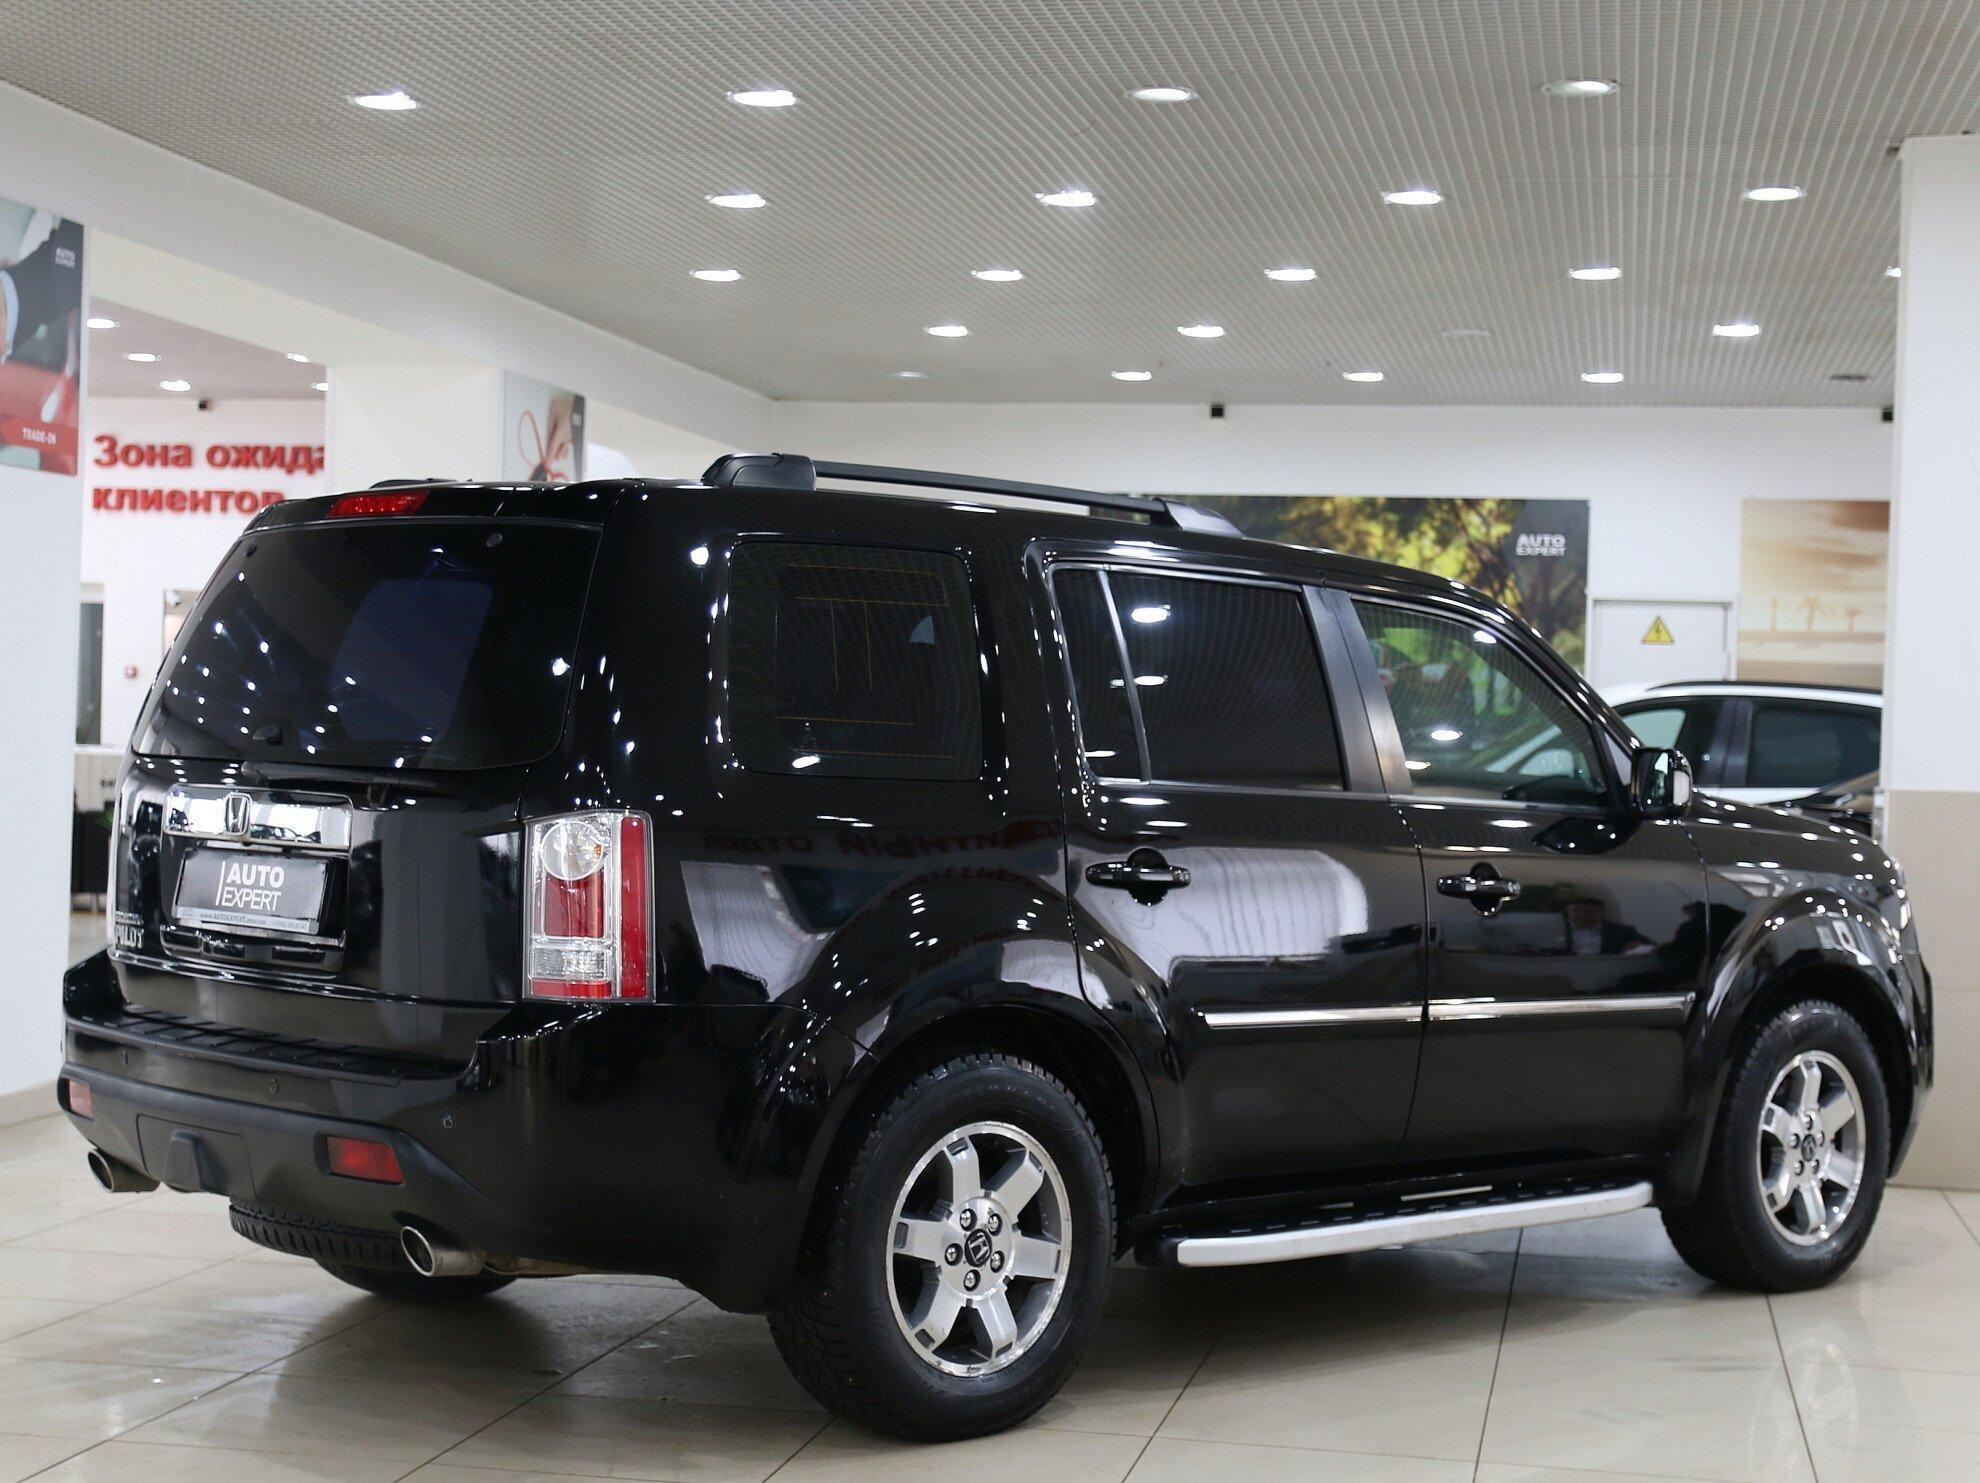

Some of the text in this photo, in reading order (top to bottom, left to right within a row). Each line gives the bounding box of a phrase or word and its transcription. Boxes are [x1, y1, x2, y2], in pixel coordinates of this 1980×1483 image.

[94, 434, 192, 467] Зона
[1517, 533, 1566, 548] AUTO
[226, 862, 285, 889] AUTO
[222, 886, 281, 911] EXPERT
